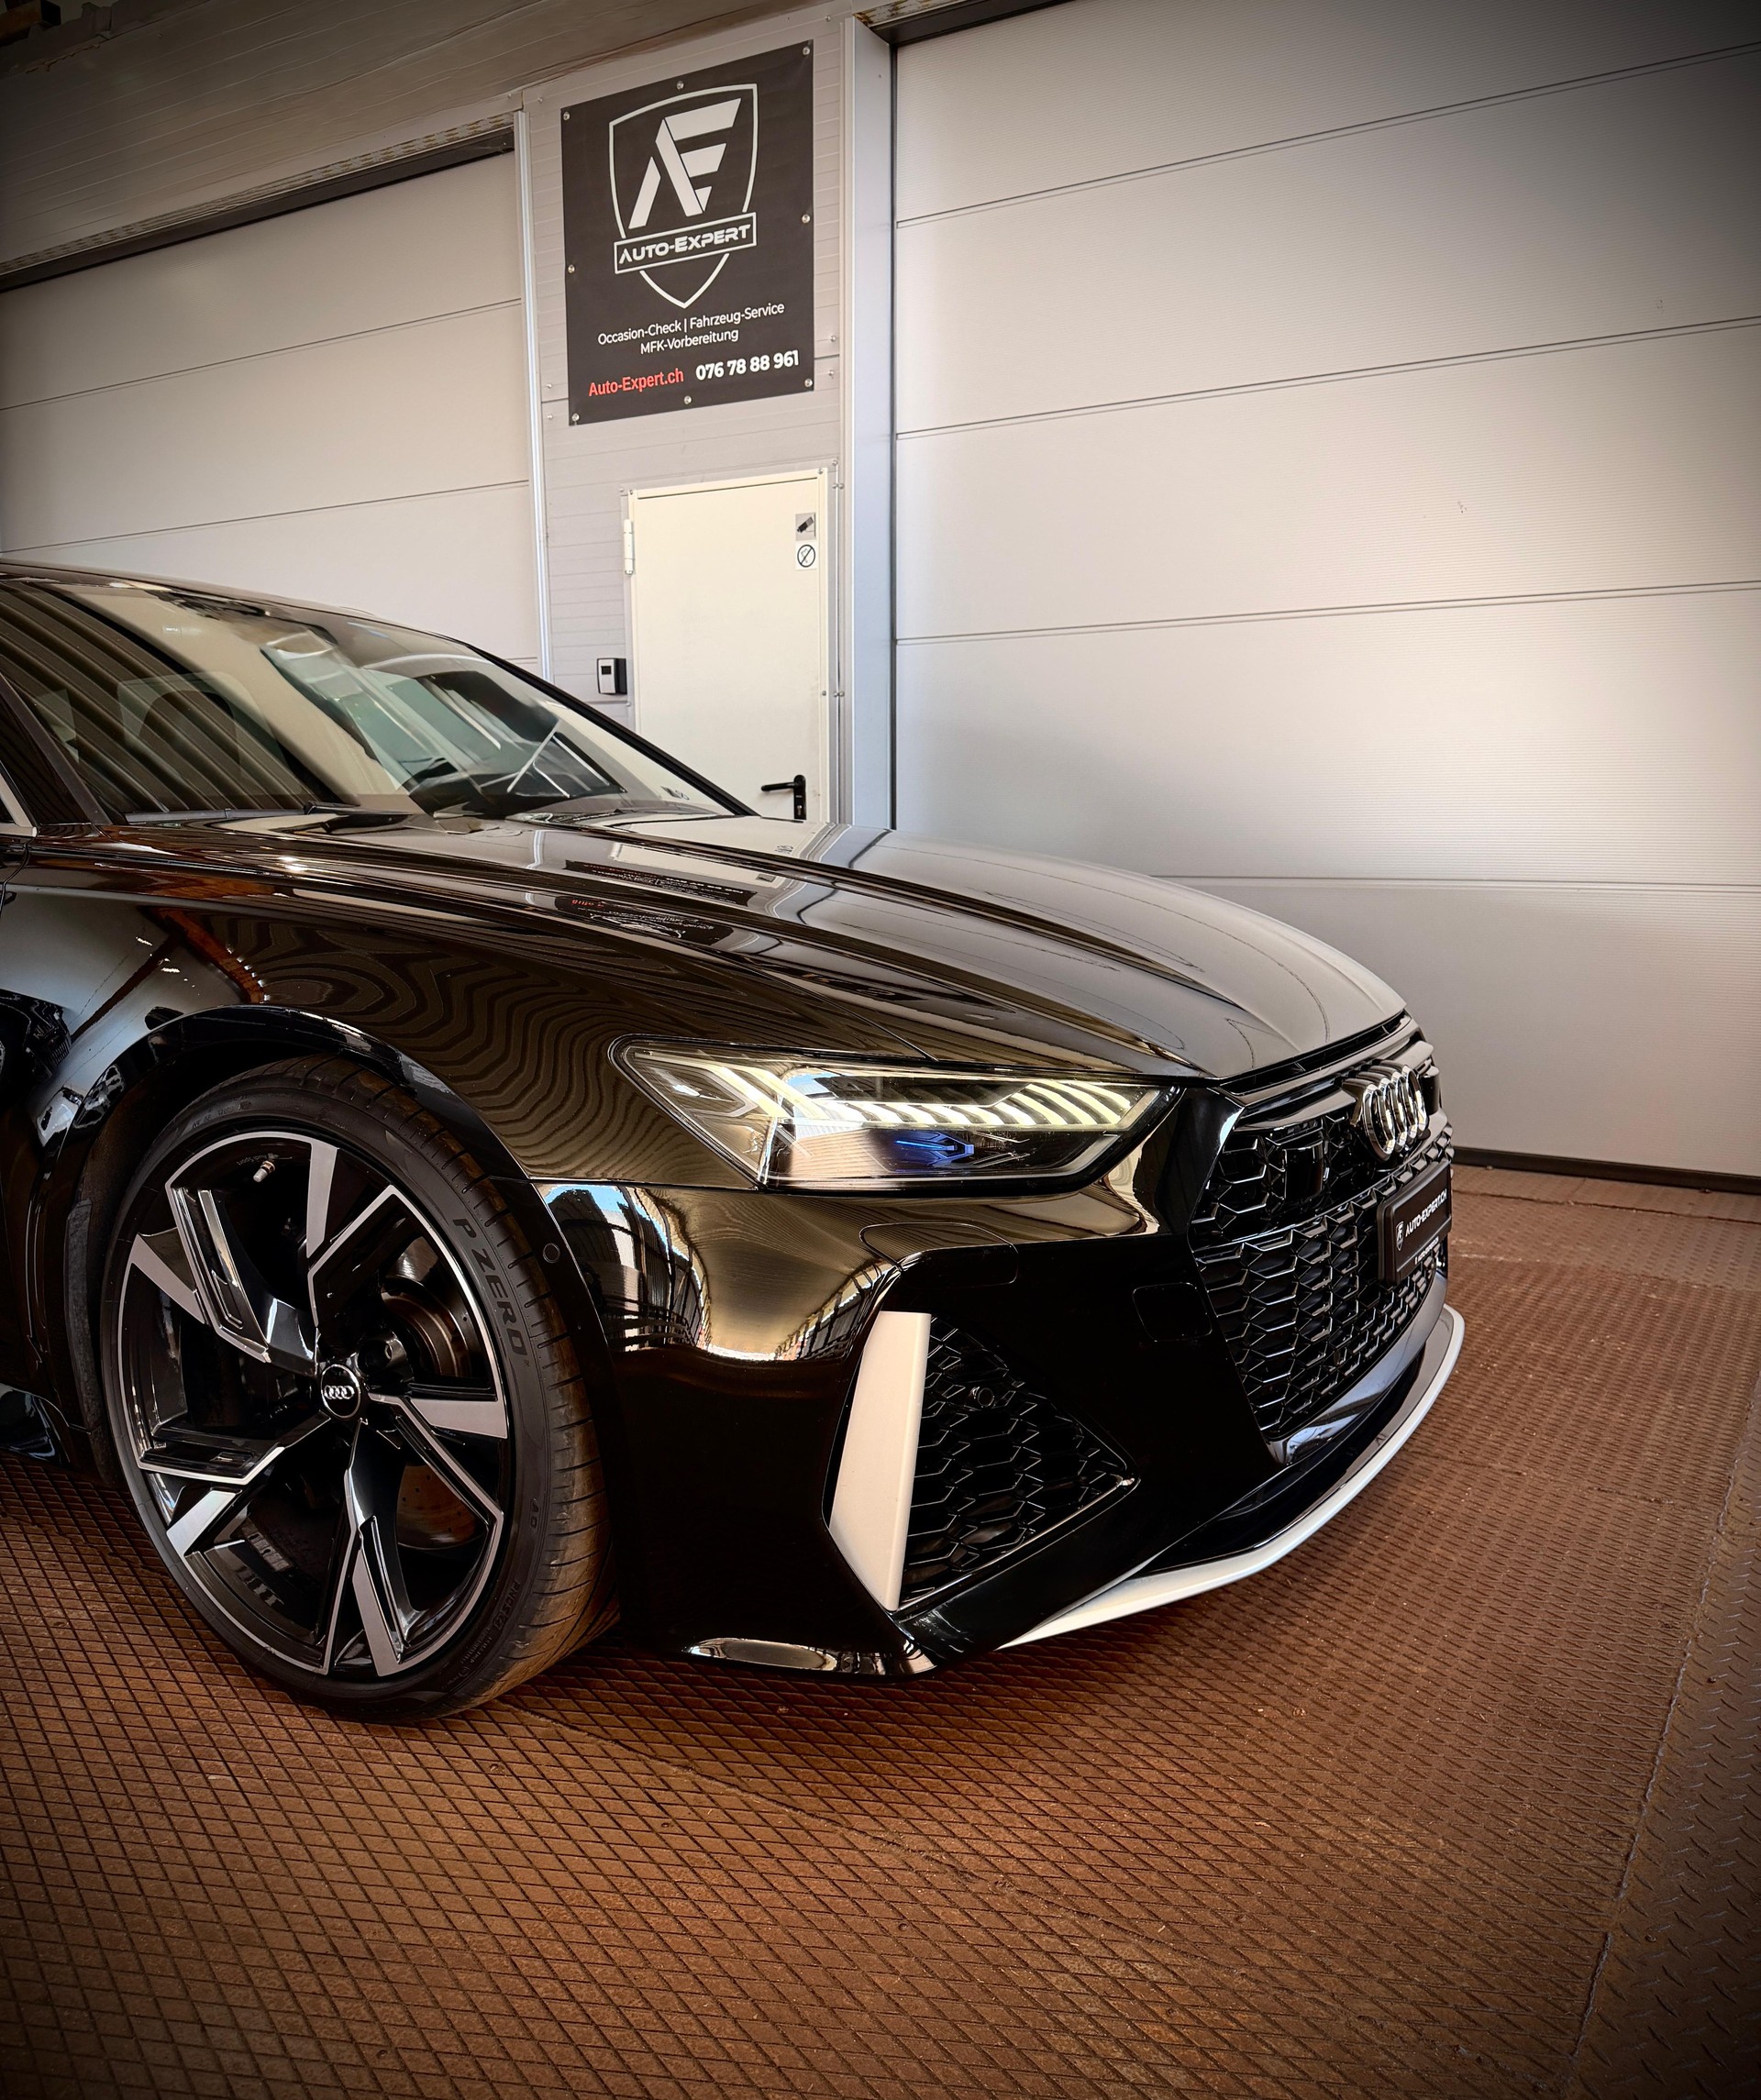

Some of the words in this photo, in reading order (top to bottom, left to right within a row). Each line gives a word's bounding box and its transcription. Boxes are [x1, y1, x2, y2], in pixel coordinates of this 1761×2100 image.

[618, 224, 751, 264] AUTO-EXPERT
[597, 319, 681, 345] Occasion-Check
[690, 303, 785, 330] Fahrzeug-Service
[640, 328, 739, 354] MFK-Vorbereitung
[588, 368, 684, 396] Auto-Expert.ch
[695, 361, 724, 381] 076
[726, 359, 747, 376] 78
[749, 355, 770, 373] 88
[773, 349, 800, 370] 961
[452, 1218, 477, 1239] P
[471, 1248, 528, 1356] ZERO
